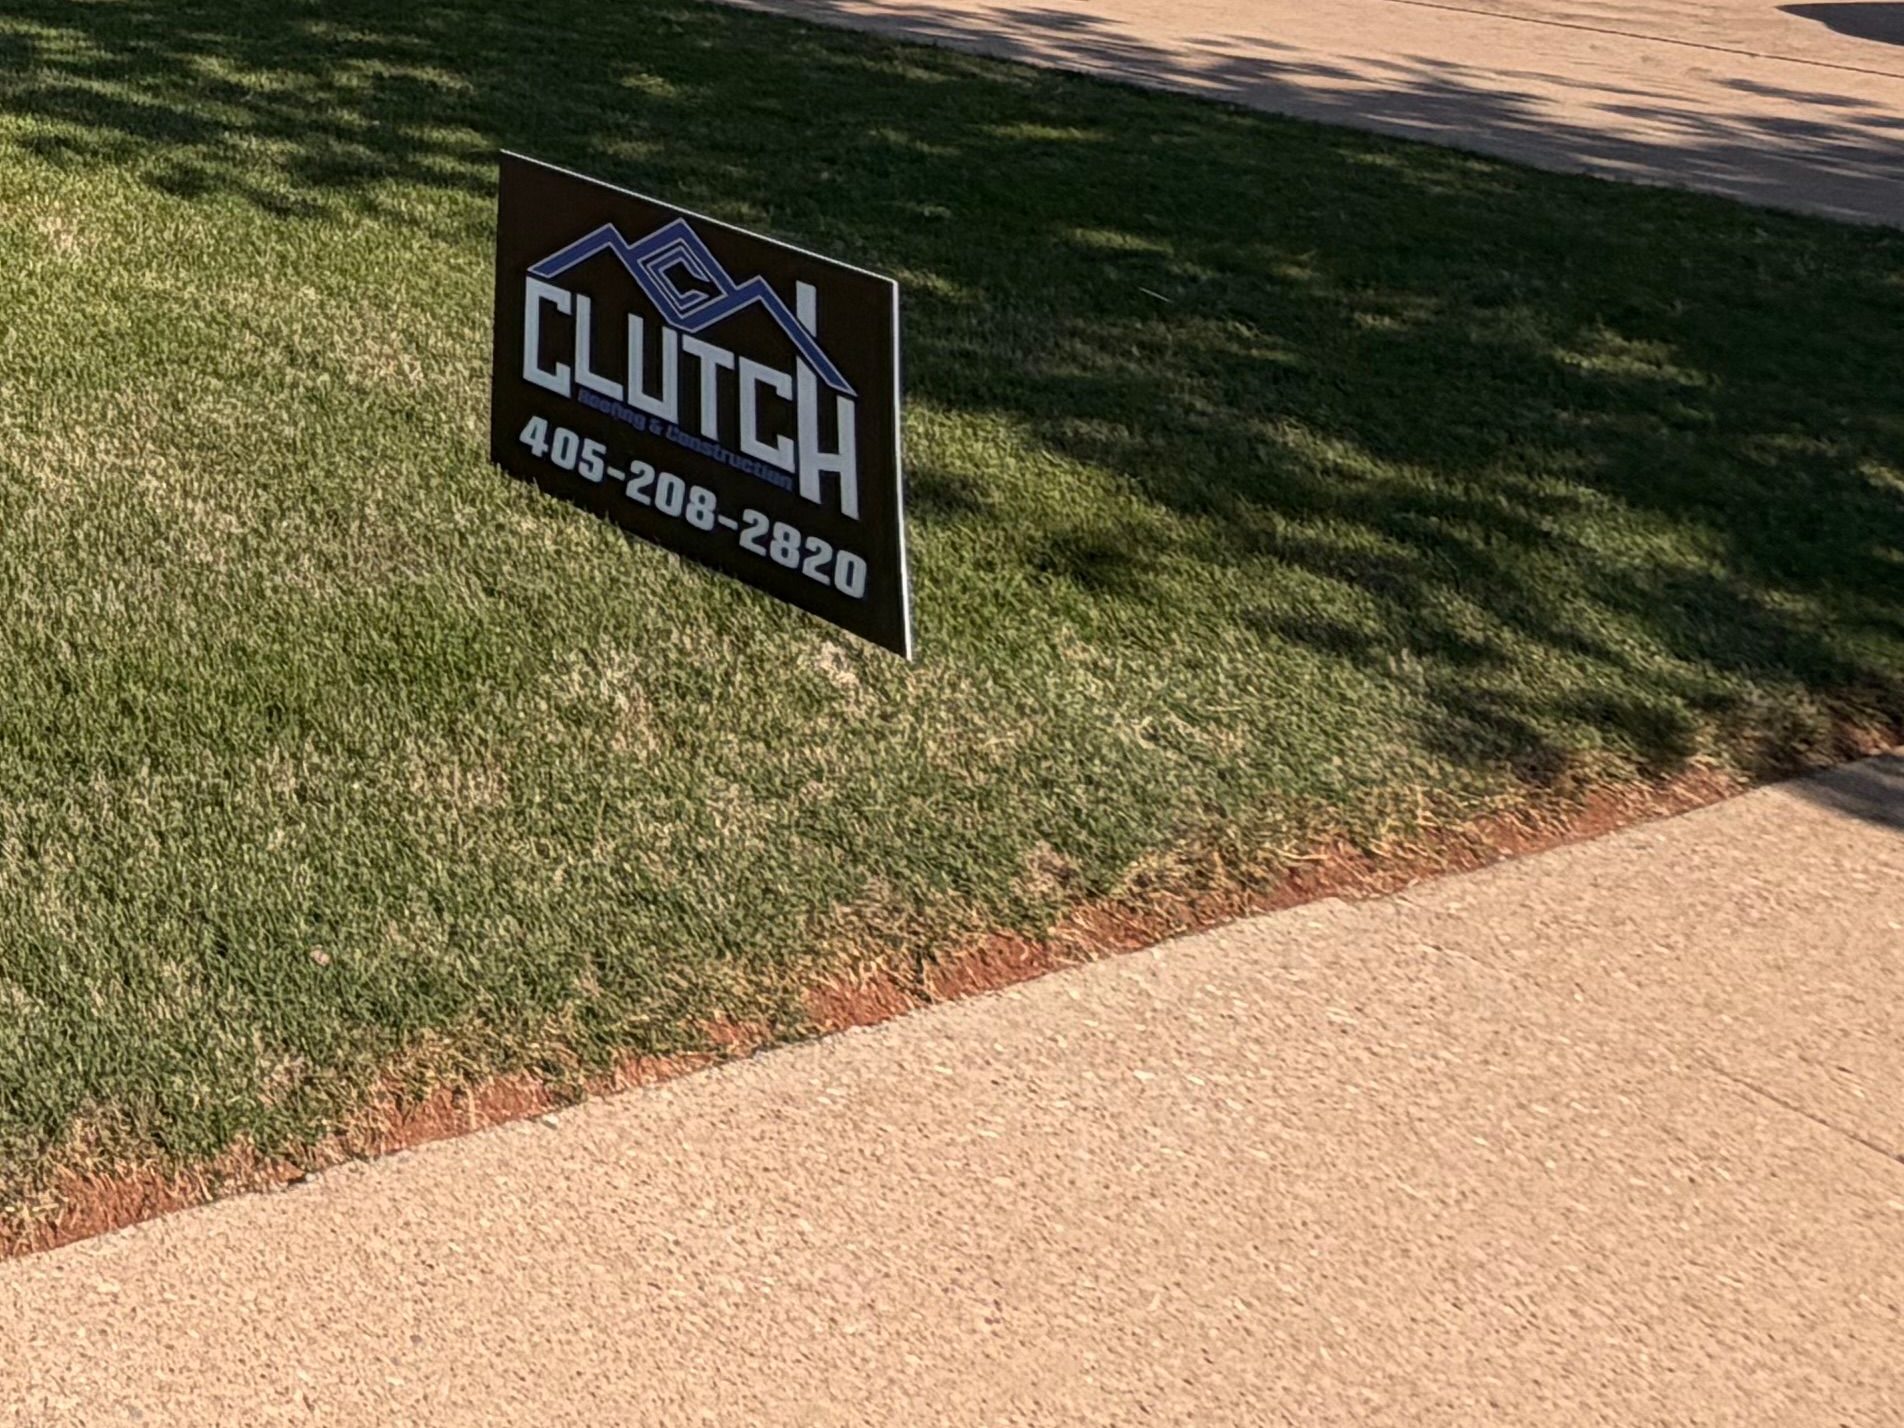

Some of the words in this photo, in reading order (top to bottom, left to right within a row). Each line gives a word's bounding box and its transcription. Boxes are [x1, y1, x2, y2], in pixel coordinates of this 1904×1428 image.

[523, 276, 860, 520] CLUTCH
[577, 387, 646, 431] Roofing
[648, 417, 663, 436] &
[665, 425, 793, 492] Construction
[519, 415, 868, 600] 405-208-2820
